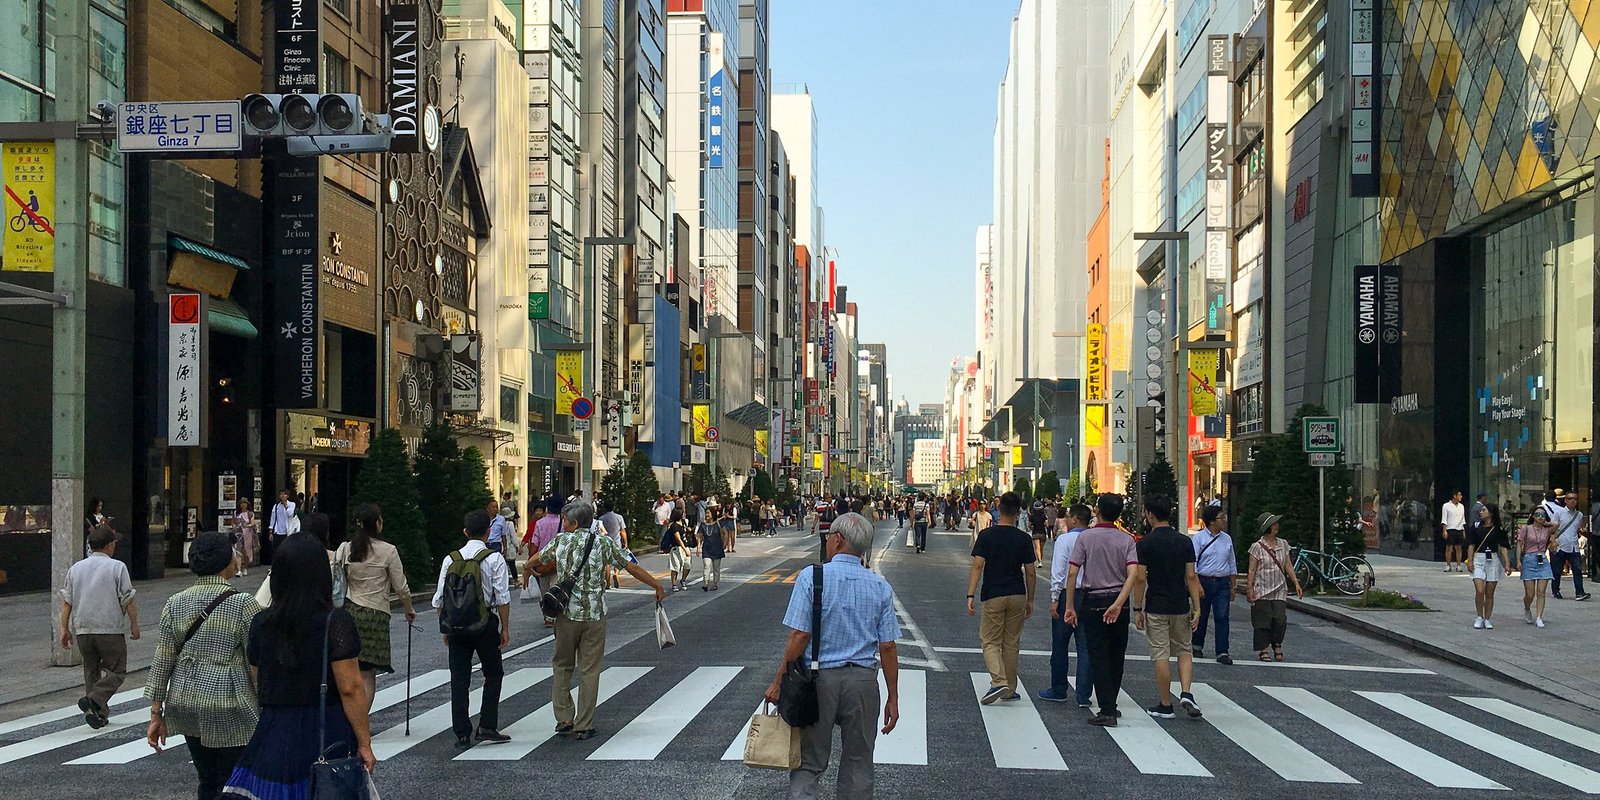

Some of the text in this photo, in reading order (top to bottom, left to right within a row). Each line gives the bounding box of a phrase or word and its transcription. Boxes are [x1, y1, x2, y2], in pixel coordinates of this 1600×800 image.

[392, 19, 417, 137] DAMIANI
[125, 103, 159, 114] 中央区
[711, 86, 722, 156] 名鉄観光
[125, 113, 232, 135] 銀座七丁目
[157, 135, 200, 147] Ginza 7
[1209, 128, 1226, 174] ダンス
[1209, 232, 1223, 278] Recella
[335, 261, 369, 287] CONSTANTIN
[1359, 275, 1375, 327] YAMAHA
[302, 264, 313, 399] VACHERON CONSTANTIN
[1397, 393, 1419, 413] YAMAHA
[1492, 394, 1513, 407] Play Easy!
[1492, 406, 1526, 420] Play Your Stage!
[1113, 390, 1127, 444] ZARA
[310, 437, 331, 448] VACHERON
